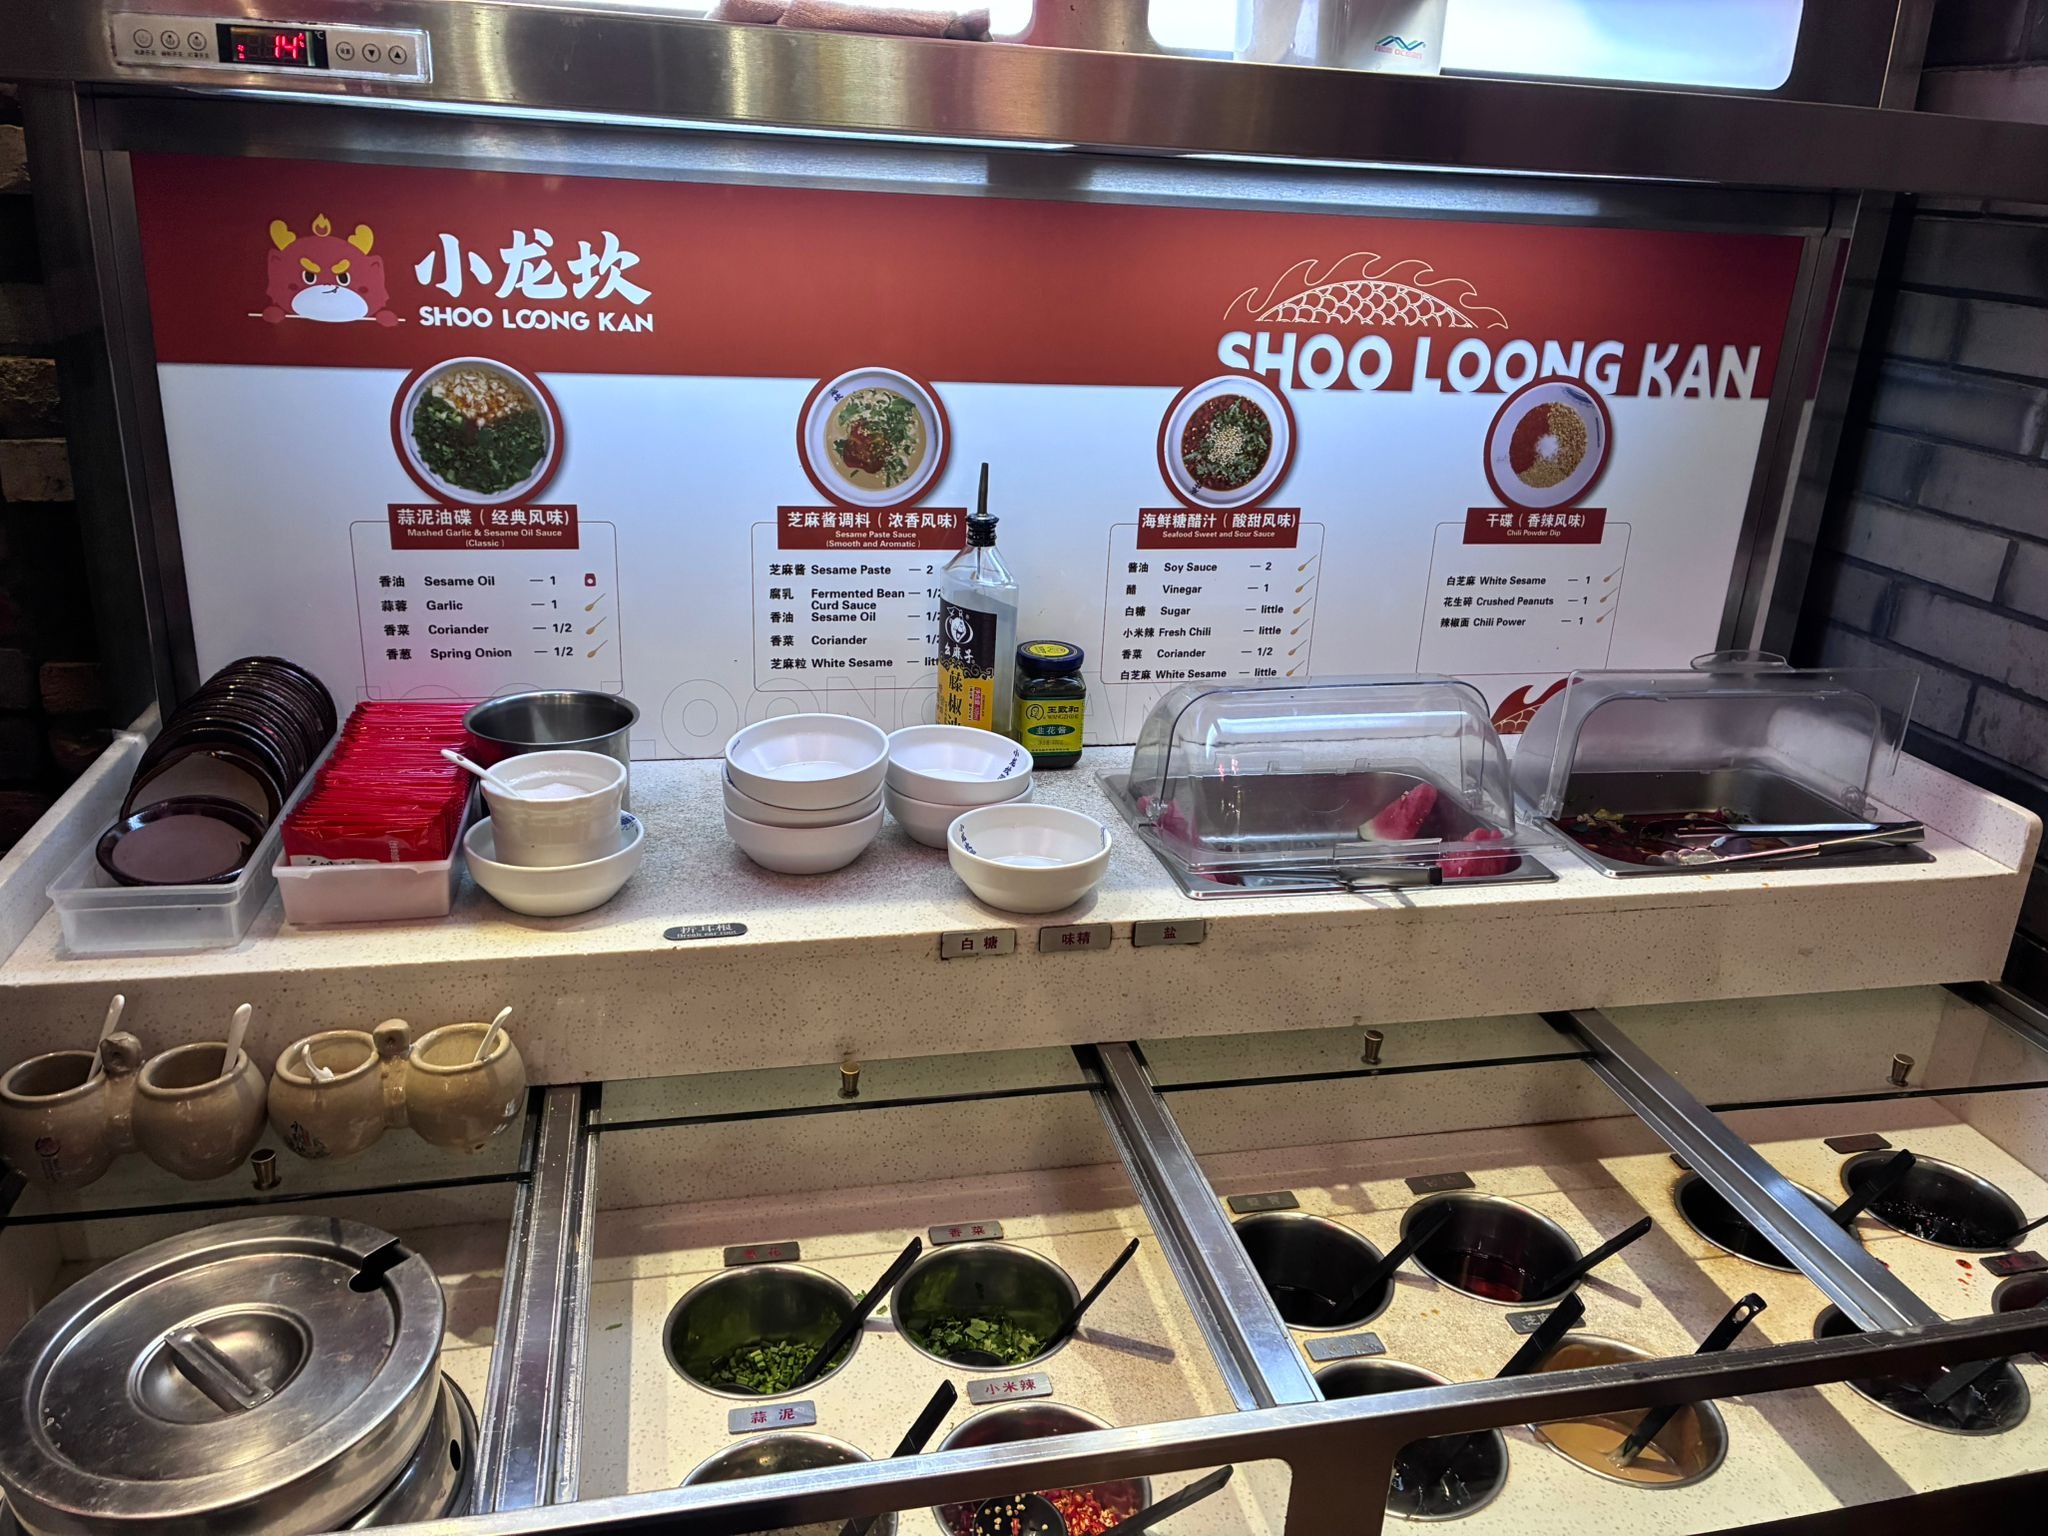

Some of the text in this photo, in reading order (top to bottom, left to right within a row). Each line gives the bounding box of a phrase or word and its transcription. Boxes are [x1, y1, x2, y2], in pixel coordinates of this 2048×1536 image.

[414, 228, 652, 305] 小龙坎
[419, 306, 654, 333] SHOO LOONG KAN
[1217, 331, 1761, 400] SHOO LOONG KAN
[407, 528, 562, 537] Mashed Garlic & Sesame Oil Sauce
[836, 530, 916, 538] Sesame Paste Sauce
[1163, 530, 1275, 538] Seafood Sweet and Sour Sauce
[863, 540, 878, 548] and
[811, 565, 857, 575] Sesame
[860, 565, 891, 575] Paste
[1164, 563, 1184, 574] Soy
[1186, 562, 1218, 572] Sauce
[379, 575, 405, 588] 香油
[424, 576, 474, 586] Sesame
[478, 576, 496, 586] Oil
[1446, 576, 1476, 586] 白芝麻
[1480, 576, 1507, 585] White
[1510, 576, 1546, 585] Sesame
[769, 588, 794, 600] 腐乳
[812, 588, 874, 598] Fermented
[877, 588, 905, 598] Bean
[1126, 584, 1137, 595] 醋
[1162, 585, 1202, 595] Vinegar
[426, 600, 463, 611] Garlic
[812, 600, 877, 610] Curd Sauce
[1476, 597, 1515, 606] Crushed
[1517, 597, 1554, 606] Peanuts
[770, 611, 794, 623] 香油
[812, 612, 858, 622] Sesame
[860, 612, 876, 622] Oil
[1125, 605, 1284, 617] 白糖 Sugar little
[1473, 618, 1494, 627] Chili
[1496, 618, 1526, 626] Power
[384, 623, 573, 636] 香菜 Coriander 1/2
[1123, 626, 1281, 638] 小米辣 Fresh Chili little
[770, 635, 794, 646] 香菜
[812, 635, 868, 646] Coriander
[430, 648, 471, 660] Spring
[475, 648, 512, 658] Onion
[554, 647, 574, 656] 1/2
[1122, 647, 1273, 660] 香菜 Coriander 1/2
[770, 658, 807, 670] 芝麻粒
[812, 658, 846, 668] White
[848, 658, 893, 668] Sesame
[1120, 668, 1277, 680] 白芝麻 White Sesame little
[1062, 931, 1091, 947] 味精
[1162, 926, 1177, 940] 盐
[960, 936, 998, 952] 白糖
[948, 1224, 986, 1238] 香菜
[984, 1378, 1036, 1395] 小米辣
[750, 1406, 796, 1424] 蒜泥
